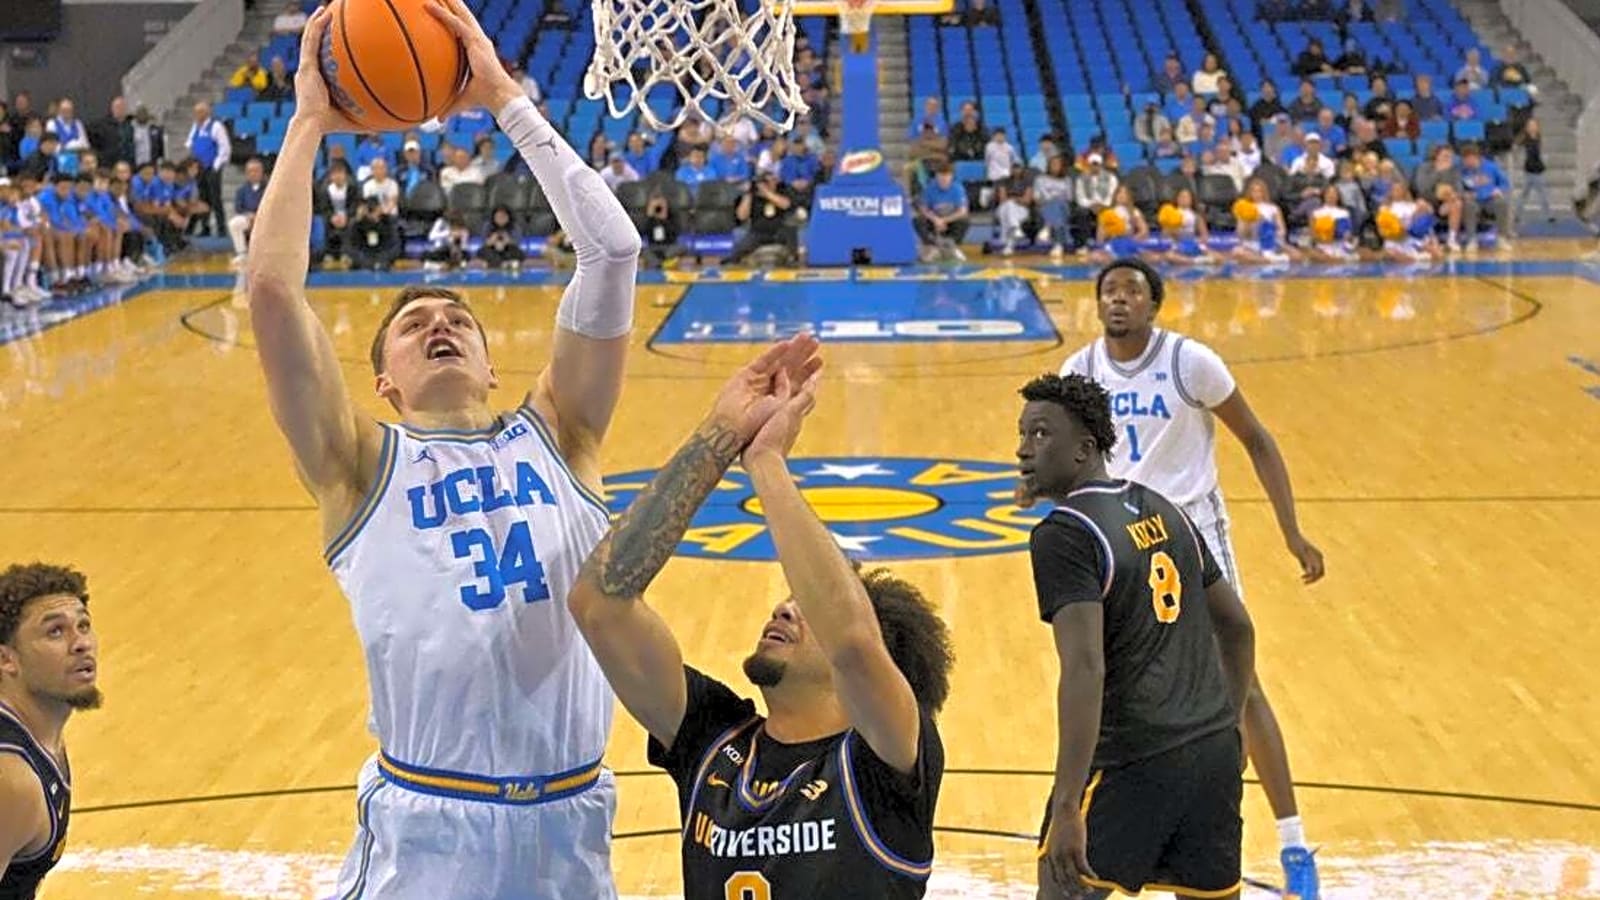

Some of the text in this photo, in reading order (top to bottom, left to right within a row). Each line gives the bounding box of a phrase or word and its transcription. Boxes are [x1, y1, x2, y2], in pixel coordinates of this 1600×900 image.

[820, 197, 879, 211] WESCOM
[1108, 392, 1171, 419] CLA
[1126, 425, 1142, 462] 1
[408, 462, 557, 530] UCLA
[451, 521, 550, 611] 34
[1149, 551, 1181, 624] 8
